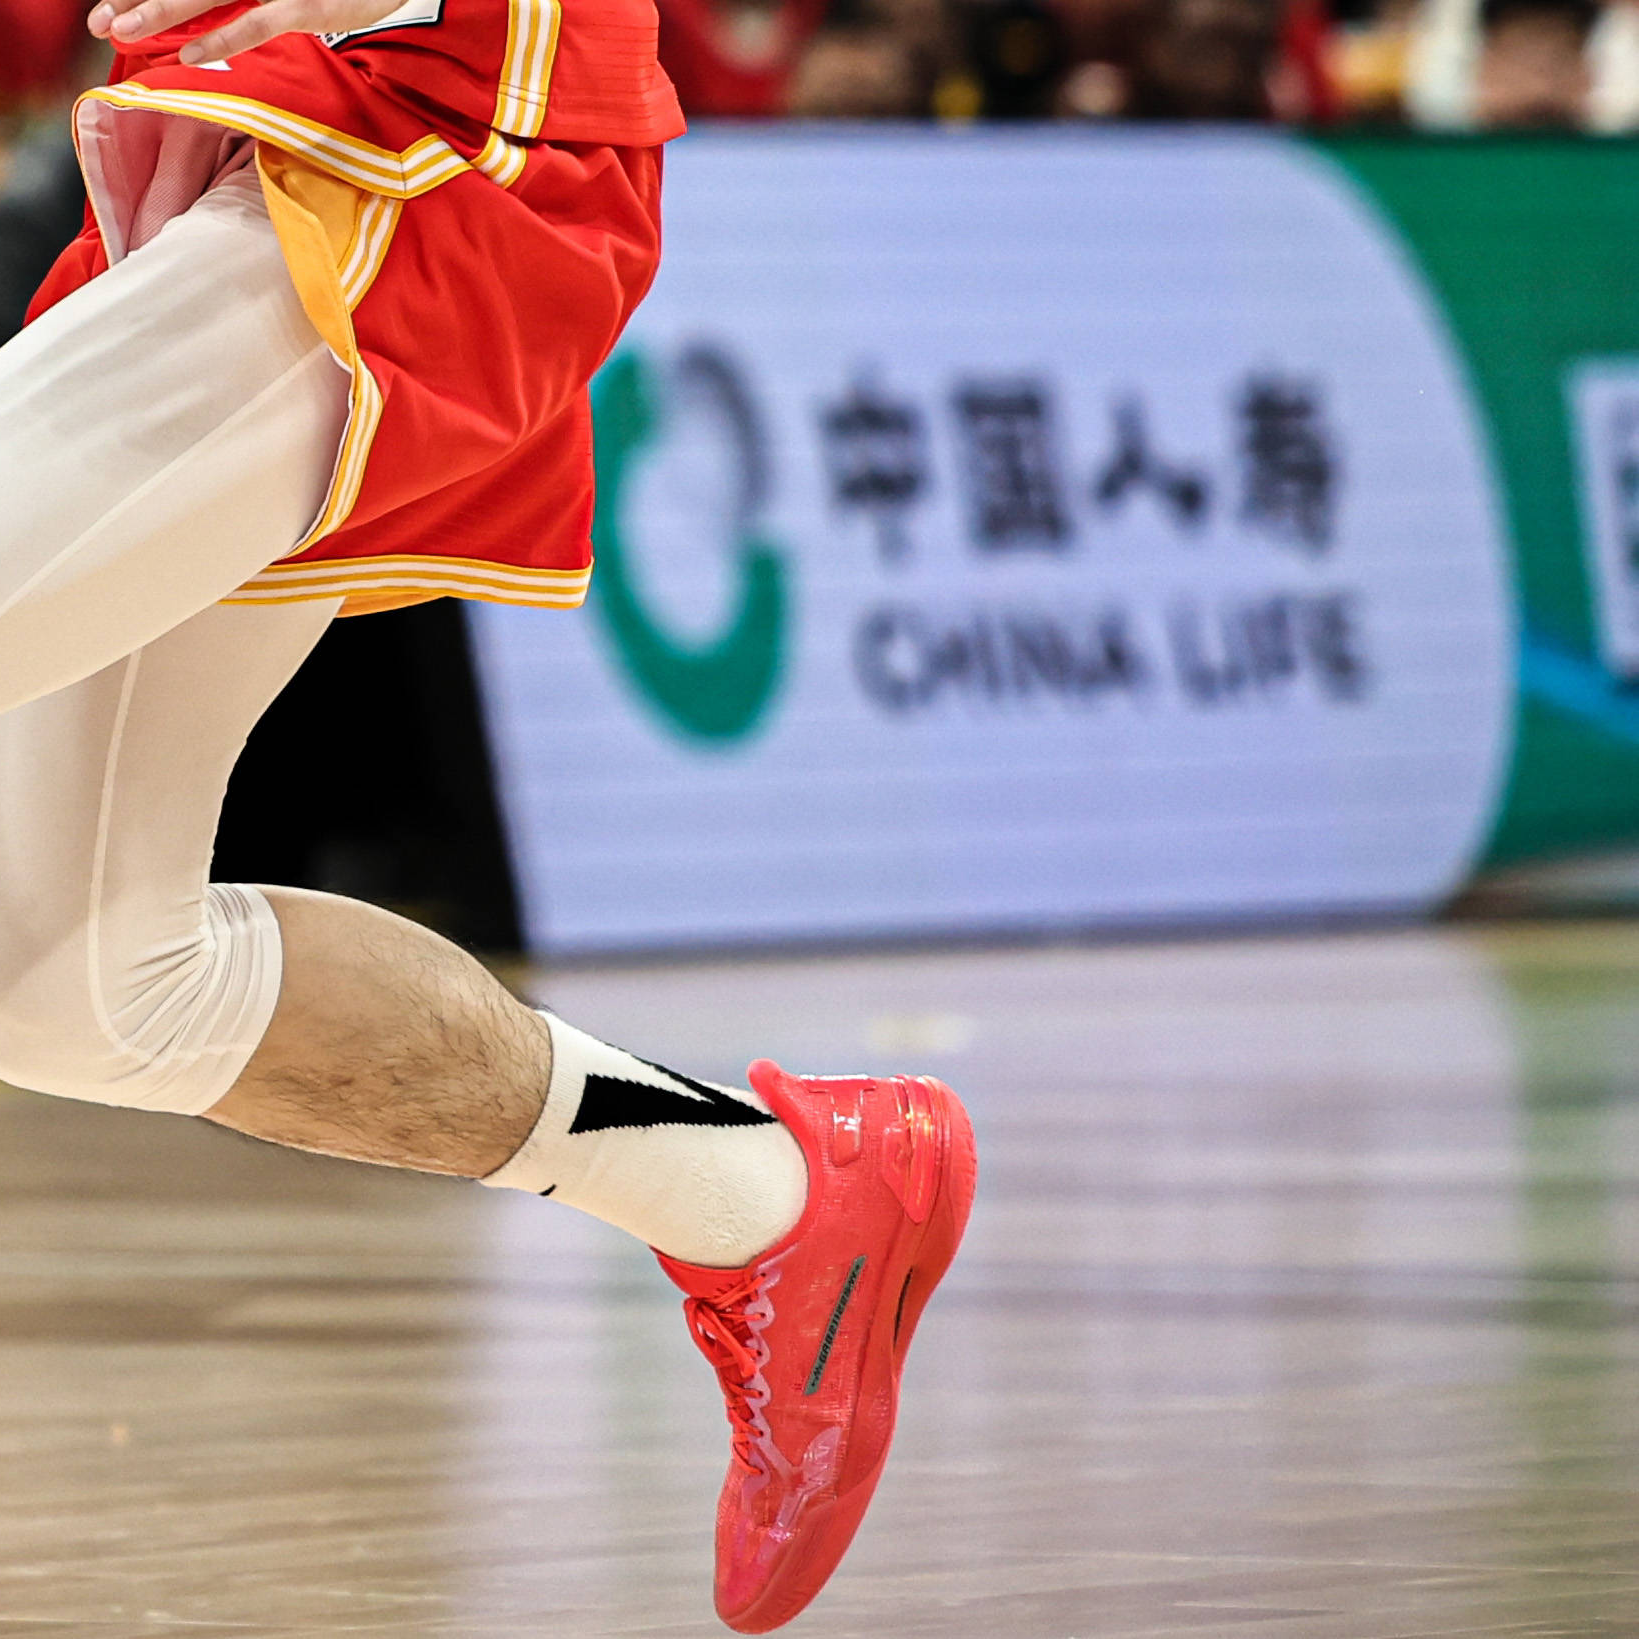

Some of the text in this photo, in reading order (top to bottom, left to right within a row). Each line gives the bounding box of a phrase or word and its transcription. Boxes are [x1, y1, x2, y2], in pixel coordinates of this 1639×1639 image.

[817, 360, 1341, 570] 中国人寿
[851, 586, 1371, 718] CHINA LIFE
